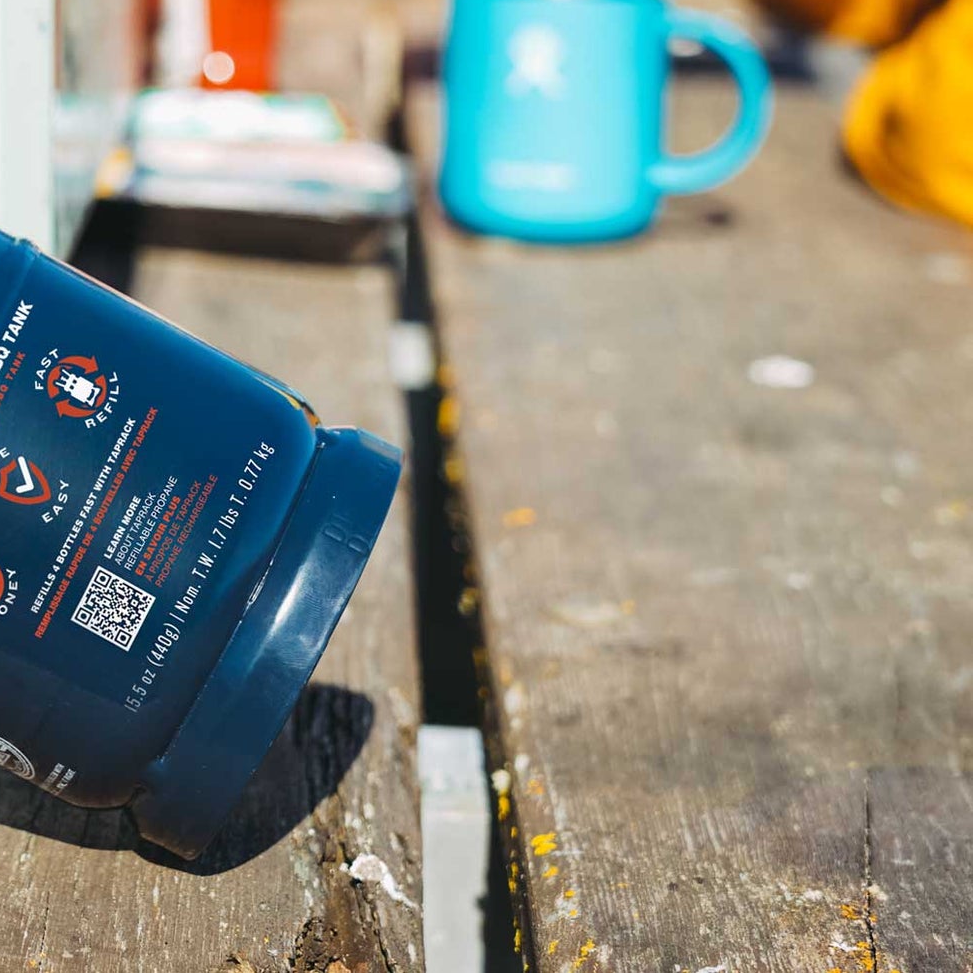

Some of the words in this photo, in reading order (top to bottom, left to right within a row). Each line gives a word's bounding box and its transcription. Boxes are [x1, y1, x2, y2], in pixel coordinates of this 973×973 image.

[1, 299, 34, 345] TANK
[5, 351, 26, 381] TANK
[34, 346, 59, 390] FAST
[84, 372, 120, 428] REFILL
[105, 416, 137, 465] TAPRACK
[252, 439, 275, 461] kg
[92, 464, 112, 492] WITH
[236, 457, 264, 491] 0.77
[41, 479, 68, 523] EASY
[78, 491, 98, 518] FAST
[218, 505, 240, 529] lbs
[229, 490, 247, 507] T.
[33, 578, 71, 639] REMPLISSAGE
[64, 545, 87, 579] RAPIDE
[81, 531, 94, 546] DE
[91, 471, 126, 525] BOUTEILLES
[119, 447, 137, 472] AVEC
[131, 406, 159, 448] TAPRACK
[55, 518, 85, 564] BOTTLES
[103, 525, 126, 559] LEARN
[120, 495, 142, 525] MORE
[113, 533, 135, 565] ABOUT
[129, 491, 156, 534] TAPRACK
[123, 518, 156, 570] REFILLABLE
[150, 475, 178, 519] PROPANE
[134, 560, 147, 575] EN
[142, 521, 167, 560] SAVOIR
[161, 494, 181, 522] PLUS
[148, 535, 173, 573] PROPOS
[168, 521, 180, 536] DE
[174, 479, 202, 522] TAPRACK
[154, 544, 182, 587] PROPANE
[175, 473, 219, 545] RECHARGEABLE
[50, 563, 61, 573] 4
[191, 548, 218, 580] T.W.
[30, 572, 56, 613] REFILLS
[174, 579, 202, 614] Nom.
[144, 620, 182, 668] (440g)
[122, 683, 148, 713] 15.5
[140, 668, 157, 685] oz
